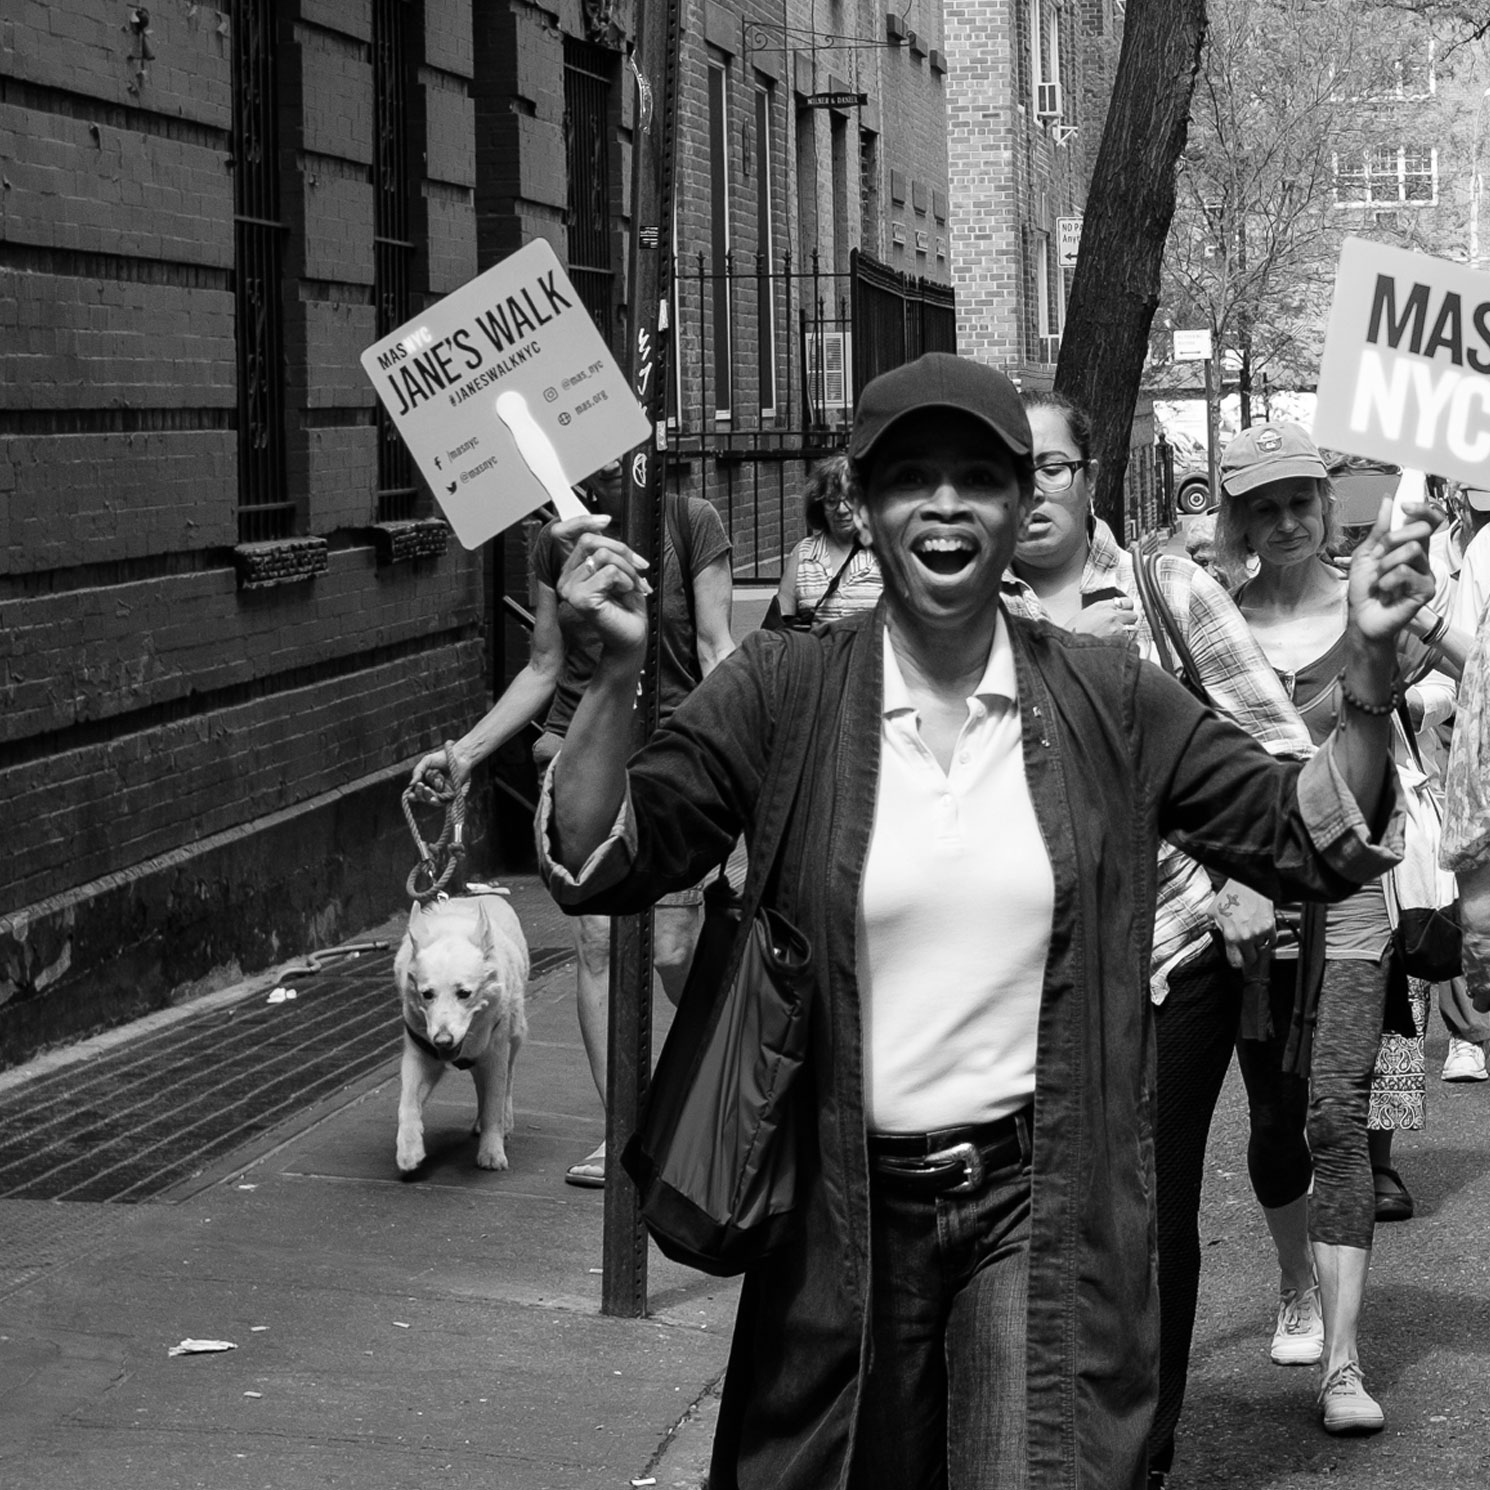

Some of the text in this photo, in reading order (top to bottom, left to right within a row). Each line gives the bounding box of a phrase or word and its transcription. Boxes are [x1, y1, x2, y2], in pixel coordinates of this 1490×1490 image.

[1062, 223, 1073, 231] NO
[388, 269, 573, 417] JANE'S WALK
[449, 340, 542, 408] #JANESWALKNYC
[561, 359, 604, 391] @mas_nyc
[574, 389, 608, 416] mas.org
[460, 455, 498, 484] @masnyc
